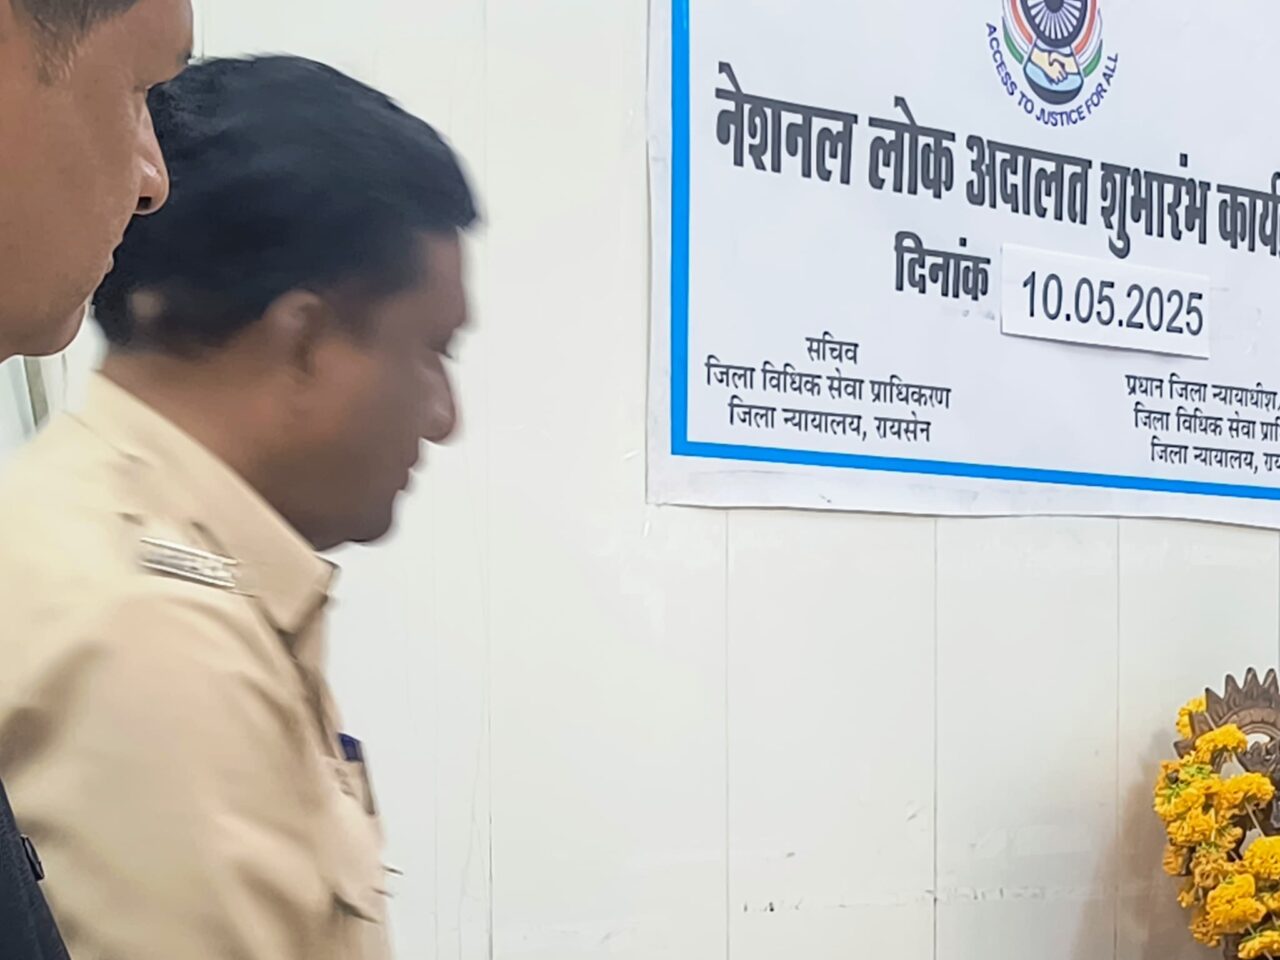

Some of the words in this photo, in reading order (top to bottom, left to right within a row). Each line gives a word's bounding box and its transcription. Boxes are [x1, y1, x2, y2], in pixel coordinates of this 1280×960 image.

[986, 22, 1018, 96] ACCESS
[1017, 91, 1034, 115] TO
[1035, 105, 1086, 127] JUSTICE
[1085, 83, 1107, 115] FOR
[1102, 52, 1118, 86] ALL
[715, 61, 858, 185] नेशनल
[868, 95, 956, 200] लोक
[966, 134, 1092, 225] अदालत
[1100, 152, 1211, 259] शुभारंभ
[894, 230, 991, 301] दिनांक
[1022, 270, 1204, 336] 10.05.2025
[805, 331, 859, 365] सचिव
[704, 354, 756, 390] जिला
[761, 360, 822, 397] विधिक
[826, 367, 864, 401] सेवा
[870, 374, 952, 409] प्राधिकरण
[1125, 374, 1164, 399] प्रधान
[1168, 372, 1208, 403] जिला
[728, 394, 776, 429] जिला
[782, 407, 867, 441] न्यायालय,
[874, 411, 931, 442] रायसेन
[1134, 401, 1170, 432] जिला
[1175, 405, 1223, 437] विधिक
[1227, 411, 1256, 440] सेवा
[1150, 435, 1188, 465] जिला
[1192, 445, 1259, 475] न्यायालय,
